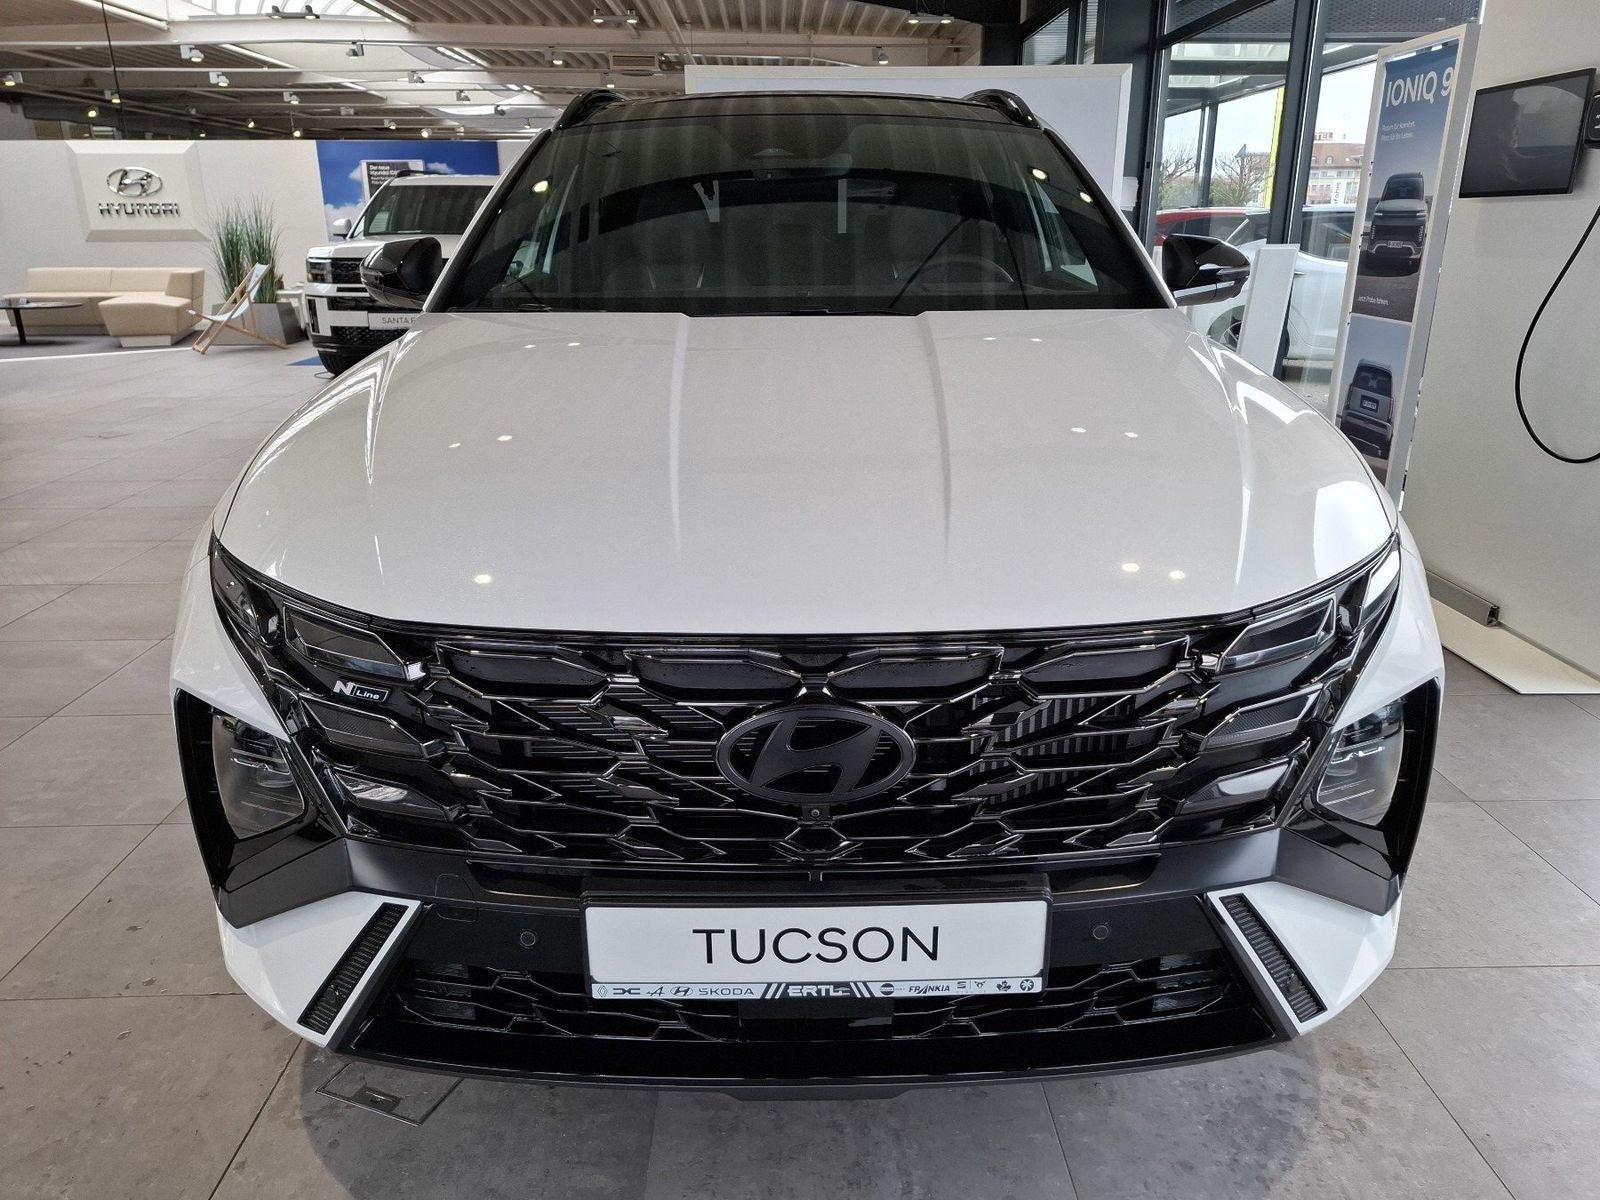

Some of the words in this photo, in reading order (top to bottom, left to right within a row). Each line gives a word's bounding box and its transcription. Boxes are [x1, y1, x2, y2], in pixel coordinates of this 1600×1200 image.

[1386, 71, 1437, 107] IONIQ
[1441, 67, 1454, 96] 9
[98, 203, 180, 216] HYUNDAI
[333, 680, 356, 696] N
[356, 690, 380, 700] Line
[692, 926, 939, 964] TUCSON
[909, 984, 950, 994] FRANKIA
